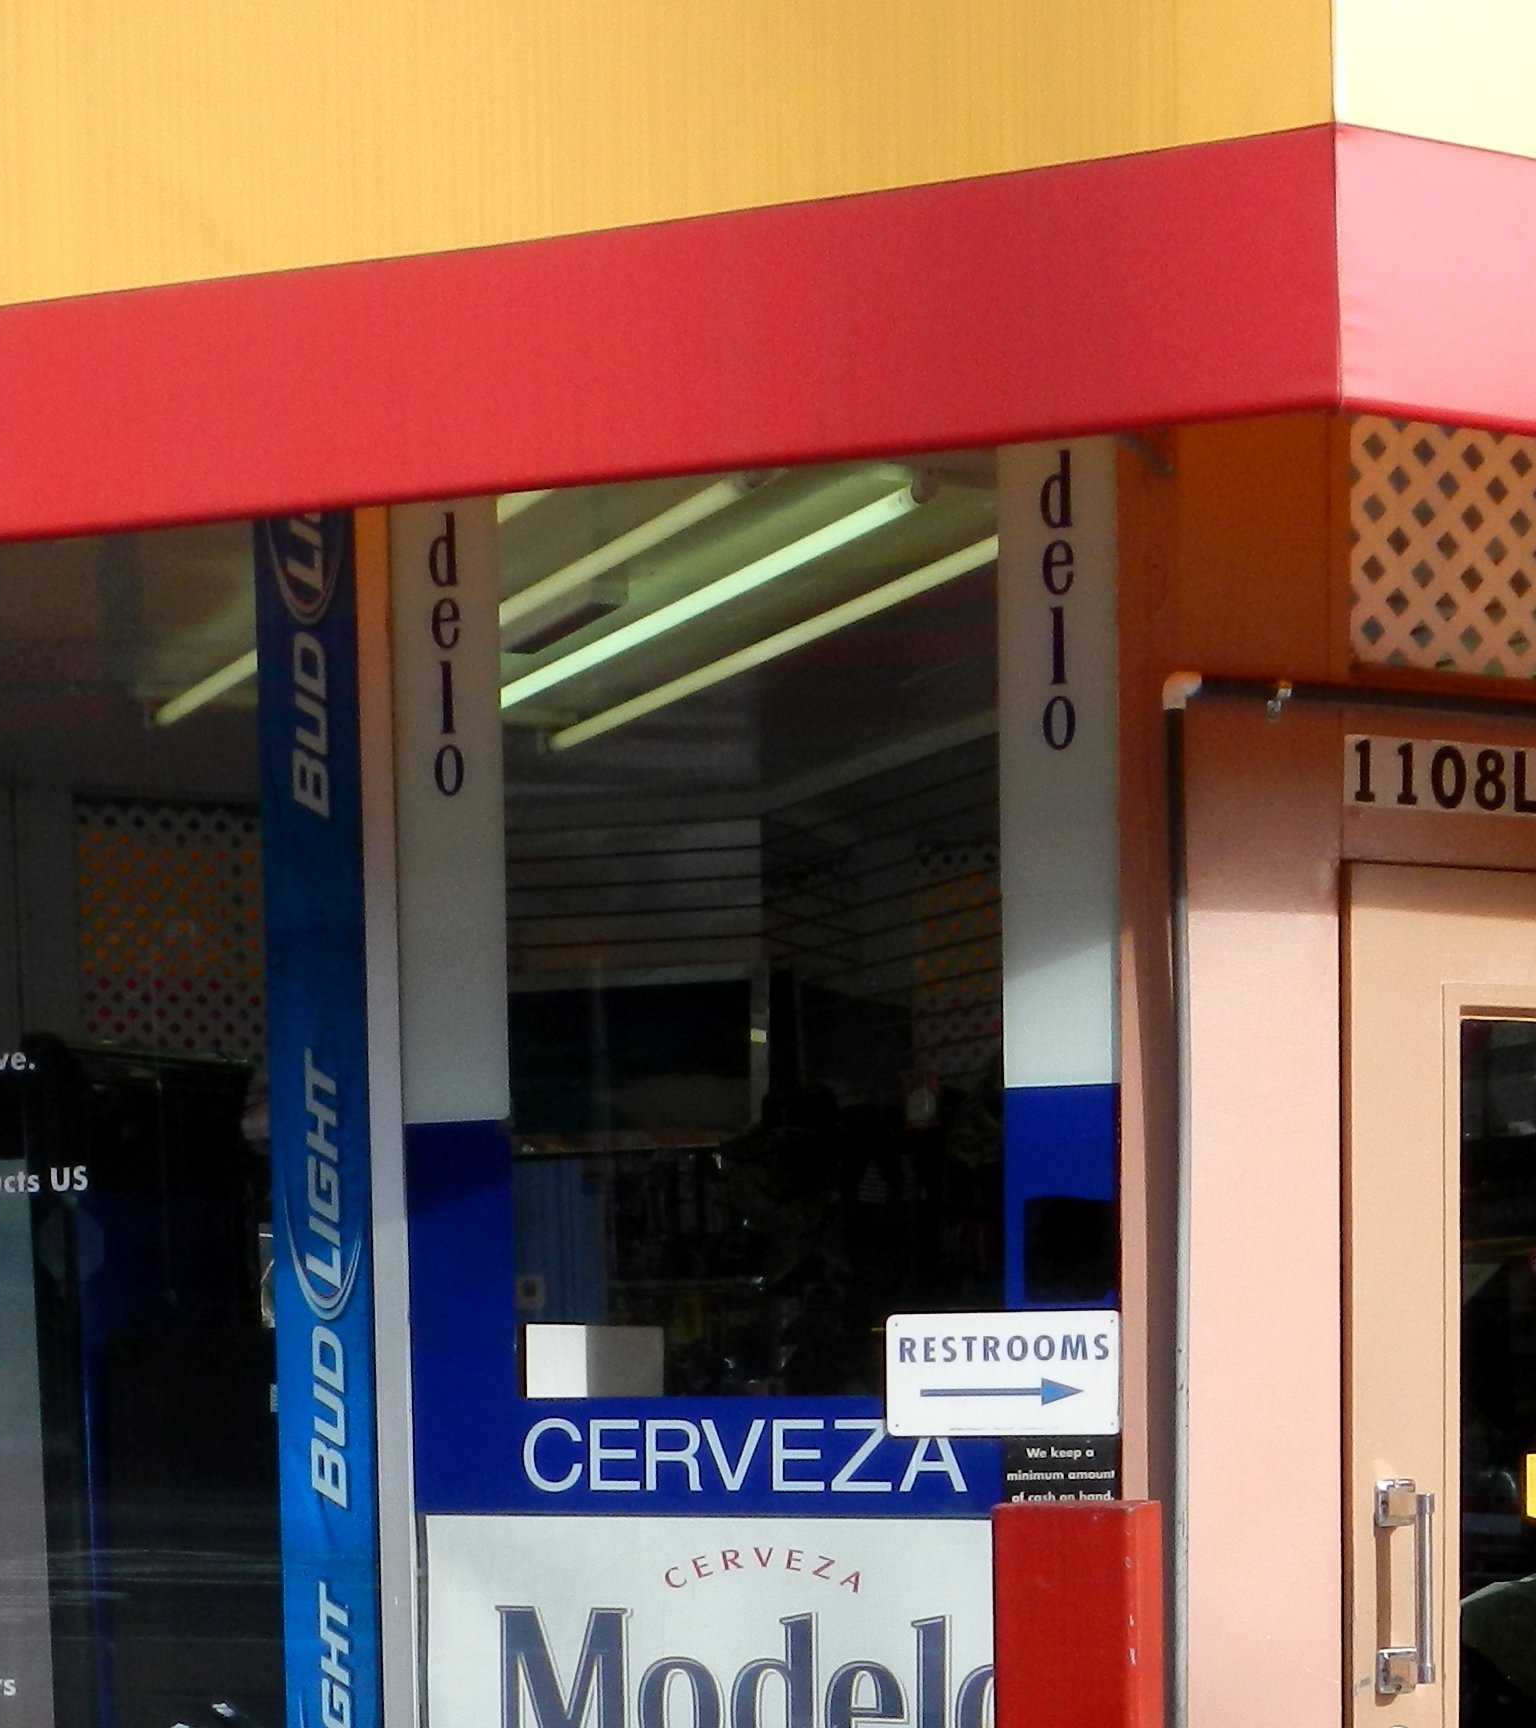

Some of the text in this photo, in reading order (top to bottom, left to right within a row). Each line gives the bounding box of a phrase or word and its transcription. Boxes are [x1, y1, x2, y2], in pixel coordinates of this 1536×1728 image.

[293, 632, 329, 819] BUD
[50, 1165, 89, 1192] US
[305, 1046, 348, 1509] BUD LIGHT
[899, 1334, 1109, 1363] RESTROOMS
[524, 1418, 968, 1493] CERVEZA
[1026, 1448, 1094, 1460] We keep a
[1006, 1469, 1115, 1481] minimum amount
[1011, 1491, 1025, 1502] of
[1028, 1491, 1055, 1502] cash
[1059, 1493, 1075, 1502] on
[664, 1546, 864, 1595] CERVEZA
